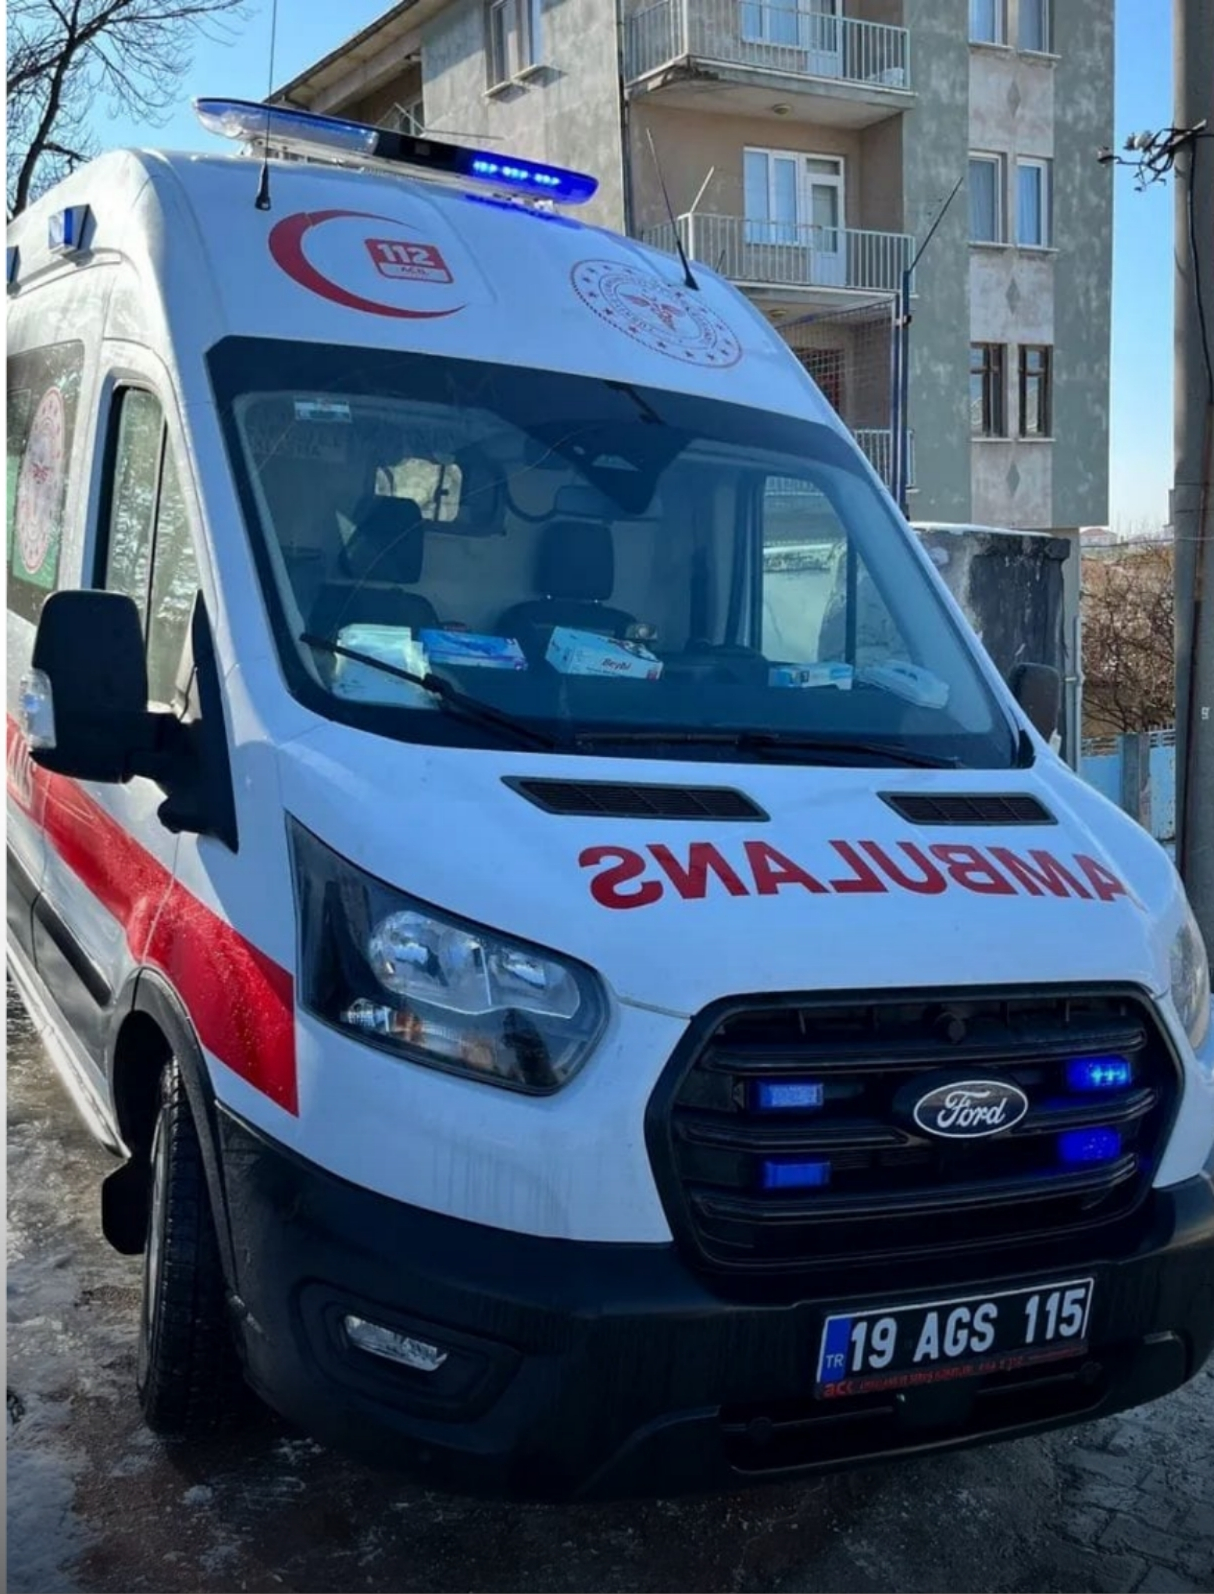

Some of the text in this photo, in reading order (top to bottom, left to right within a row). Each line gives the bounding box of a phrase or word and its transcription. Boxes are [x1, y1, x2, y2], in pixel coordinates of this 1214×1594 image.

[377, 244, 435, 267] 112
[937, 1090, 1008, 1129] Ford
[825, 1288, 1086, 1372] TR 19 AGS 115
